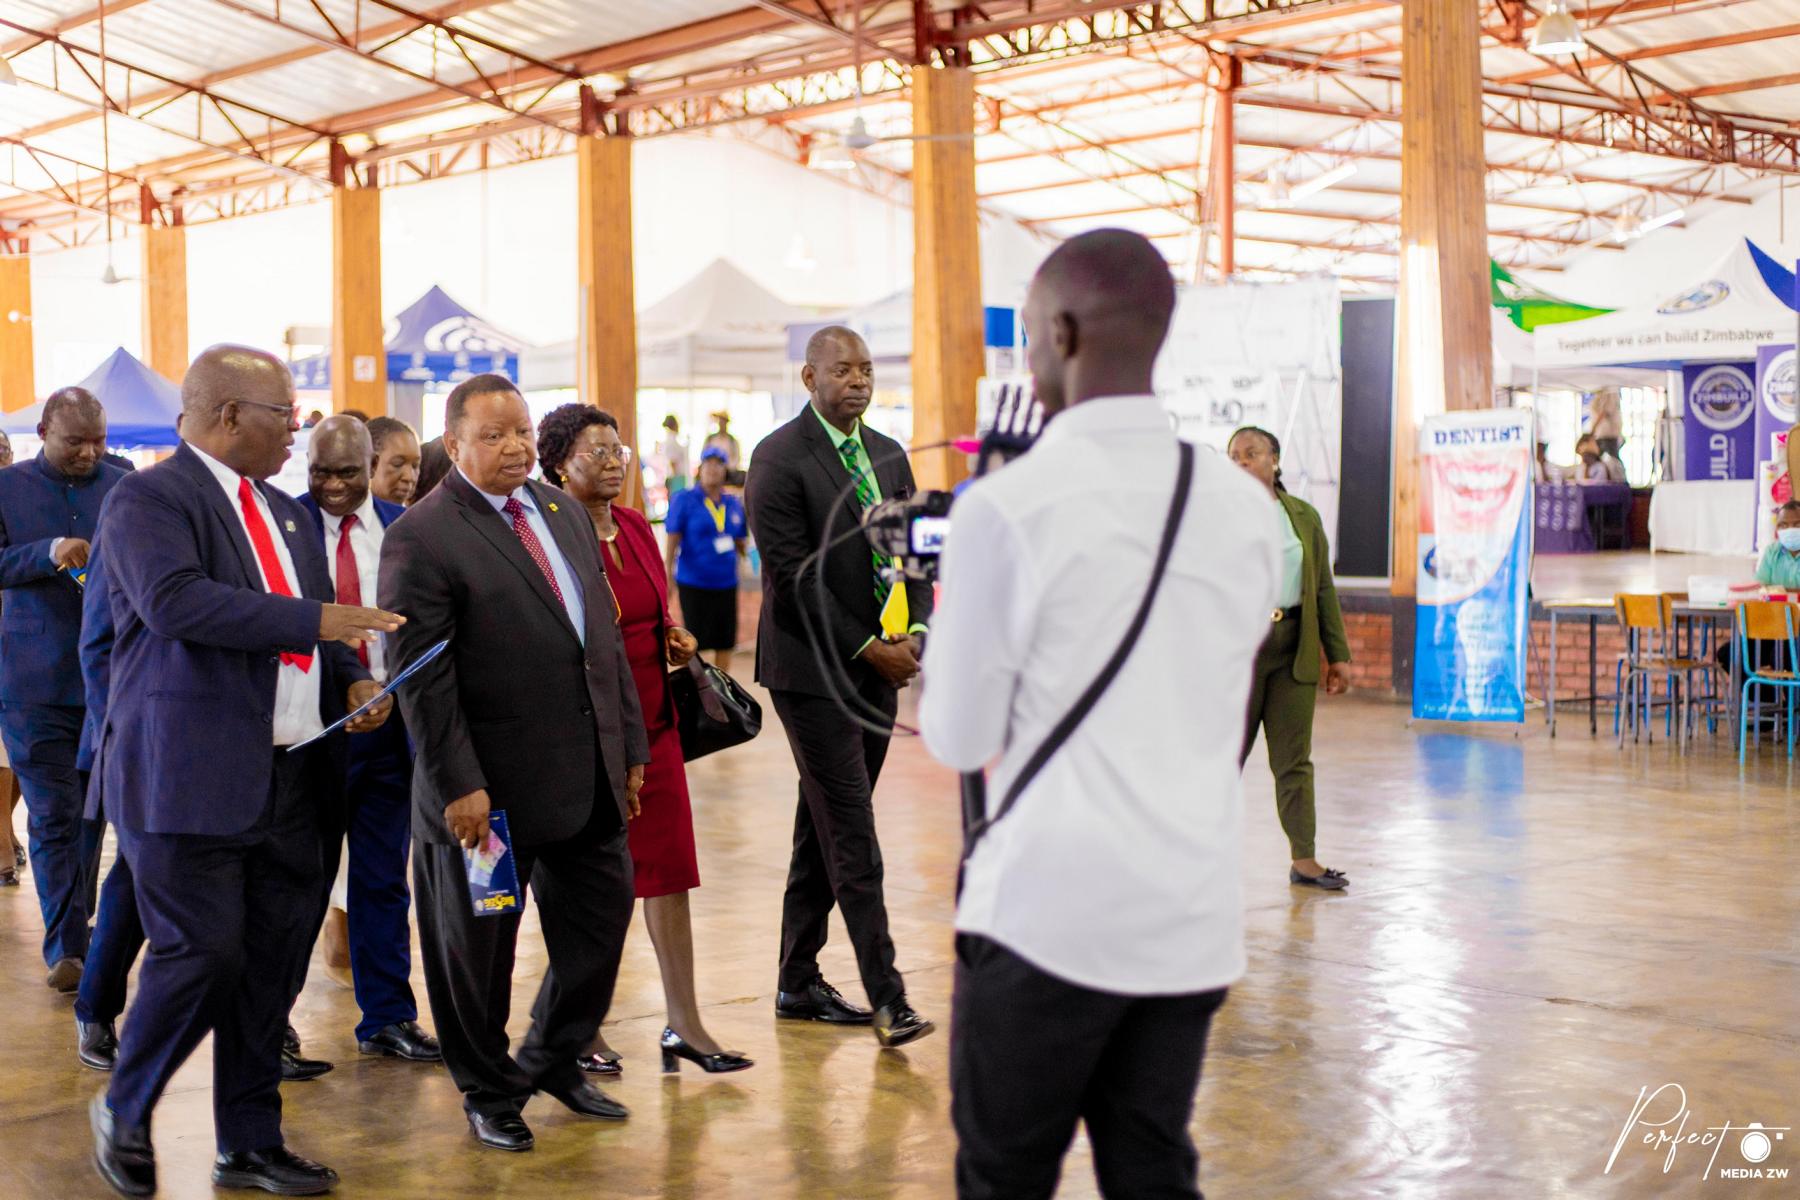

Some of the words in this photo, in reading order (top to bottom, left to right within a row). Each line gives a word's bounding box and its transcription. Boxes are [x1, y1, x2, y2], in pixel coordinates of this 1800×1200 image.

[1558, 337, 1612, 353] Together
[1616, 335, 1634, 346] we
[1638, 333, 1661, 344] can
[1665, 330, 1698, 343] build
[1703, 328, 1775, 342] Zimbabwe
[1434, 425, 1524, 444] DENTIST
